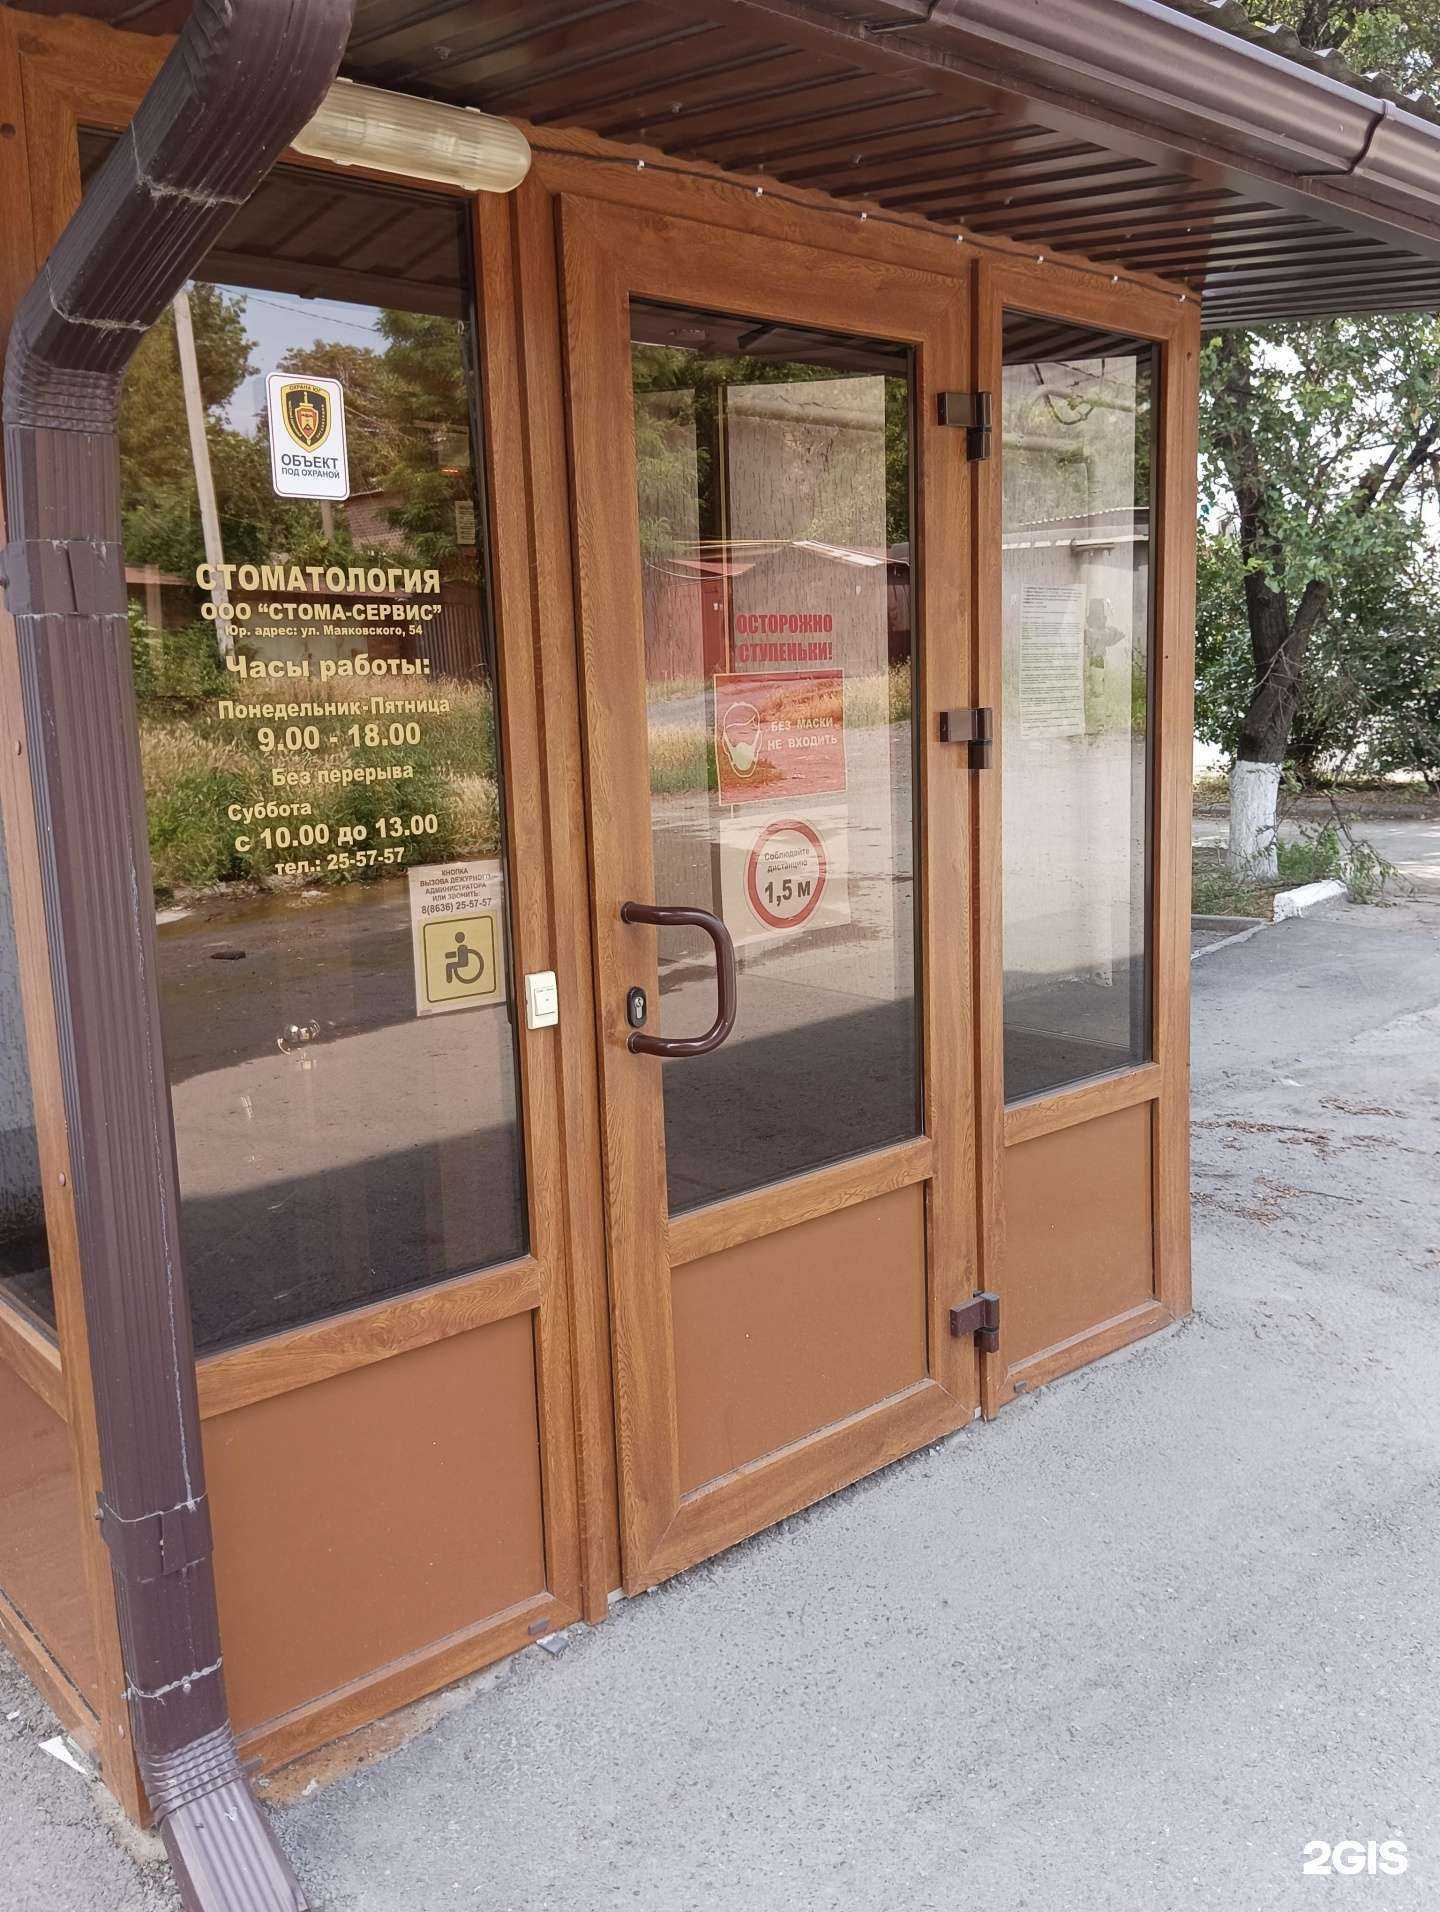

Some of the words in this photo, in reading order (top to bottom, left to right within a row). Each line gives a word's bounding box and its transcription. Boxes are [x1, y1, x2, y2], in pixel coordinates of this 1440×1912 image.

[281, 453, 339, 470] ОБЪЕКТ
[281, 467, 300, 477] ПОД
[301, 468, 340, 480] ОХРАНОЙ
[195, 563, 441, 594] СТОМАТОЛОГИЯ
[200, 602, 252, 621] ООО
[224, 625, 251, 637] Юр.
[255, 626, 298, 637] адрес:
[301, 626, 320, 637] ул.
[323, 625, 406, 638] Маяковского,
[408, 624, 424, 636] 54
[736, 613, 834, 635] ОСТОРОЖНО
[738, 641, 834, 663] СТУПЕНЬКИ!
[225, 655, 310, 679] Часы
[320, 654, 431, 682] работы:
[218, 696, 451, 721] Понедельник-Пятница
[771, 720, 791, 732] БЕЗ
[797, 717, 834, 731] МАСКИ
[257, 725, 321, 753] 9.00
[348, 722, 421, 749] 18.00
[768, 739, 783, 752] НЕ
[787, 734, 838, 749] ВХОДИТЬ
[271, 767, 311, 787] Без
[317, 764, 414, 786] перерыва
[227, 802, 312, 825] Суббота
[234, 834, 251, 852] с
[260, 824, 330, 850] 10.00
[337, 826, 367, 846] до
[375, 814, 439, 838] 13.00
[274, 857, 321, 876] тел.:
[326, 847, 405, 872] 25-57-57
[764, 849, 810, 861] Соблюдайте
[441, 867, 469, 876] КНОПКА
[419, 879, 449, 887] ВЫЗОВА
[425, 882, 487, 895] АДМИНИСТРАТОРА
[764, 879, 793, 906] 1,5
[421, 902, 454, 915] 8(8636)
[456, 898, 492, 910] 25-57-57
[432, 895, 447, 903] ИЛИ
